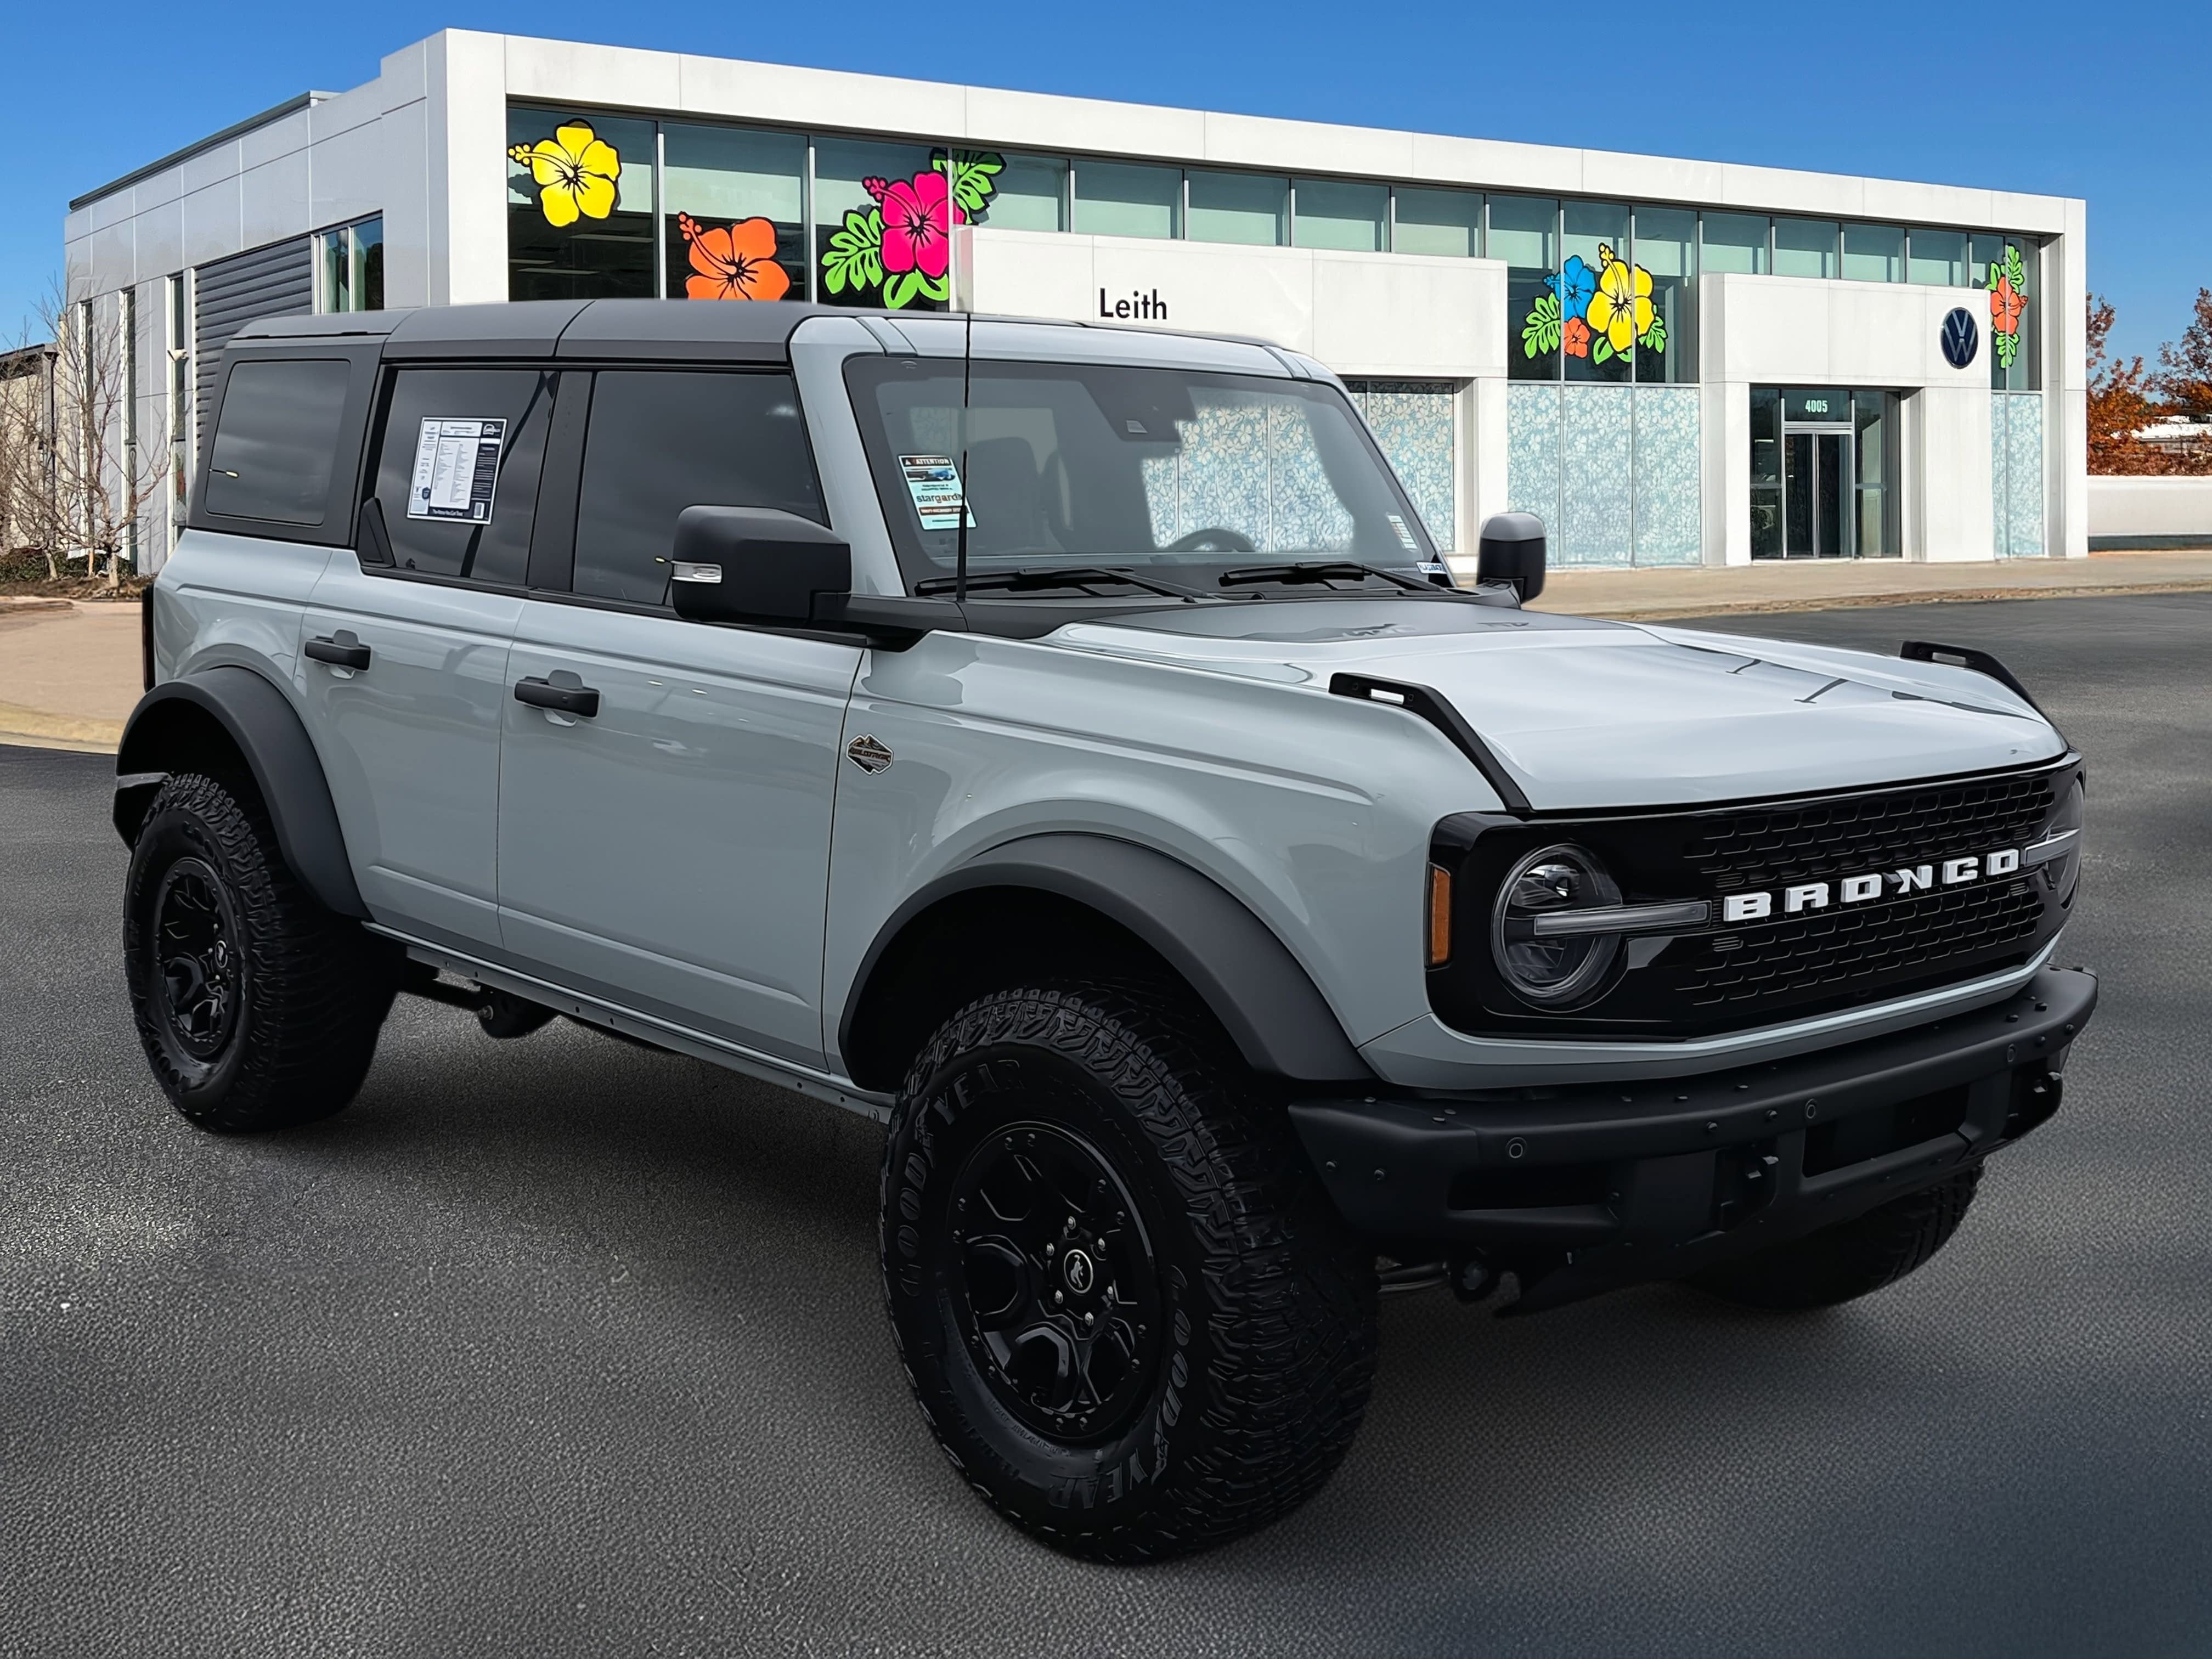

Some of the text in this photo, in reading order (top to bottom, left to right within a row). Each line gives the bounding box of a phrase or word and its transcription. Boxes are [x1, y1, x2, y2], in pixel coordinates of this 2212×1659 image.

[1100, 287, 1167, 320] Leith
[1805, 399, 1828, 413] 4005
[1723, 849, 2019, 922] BRONCO
